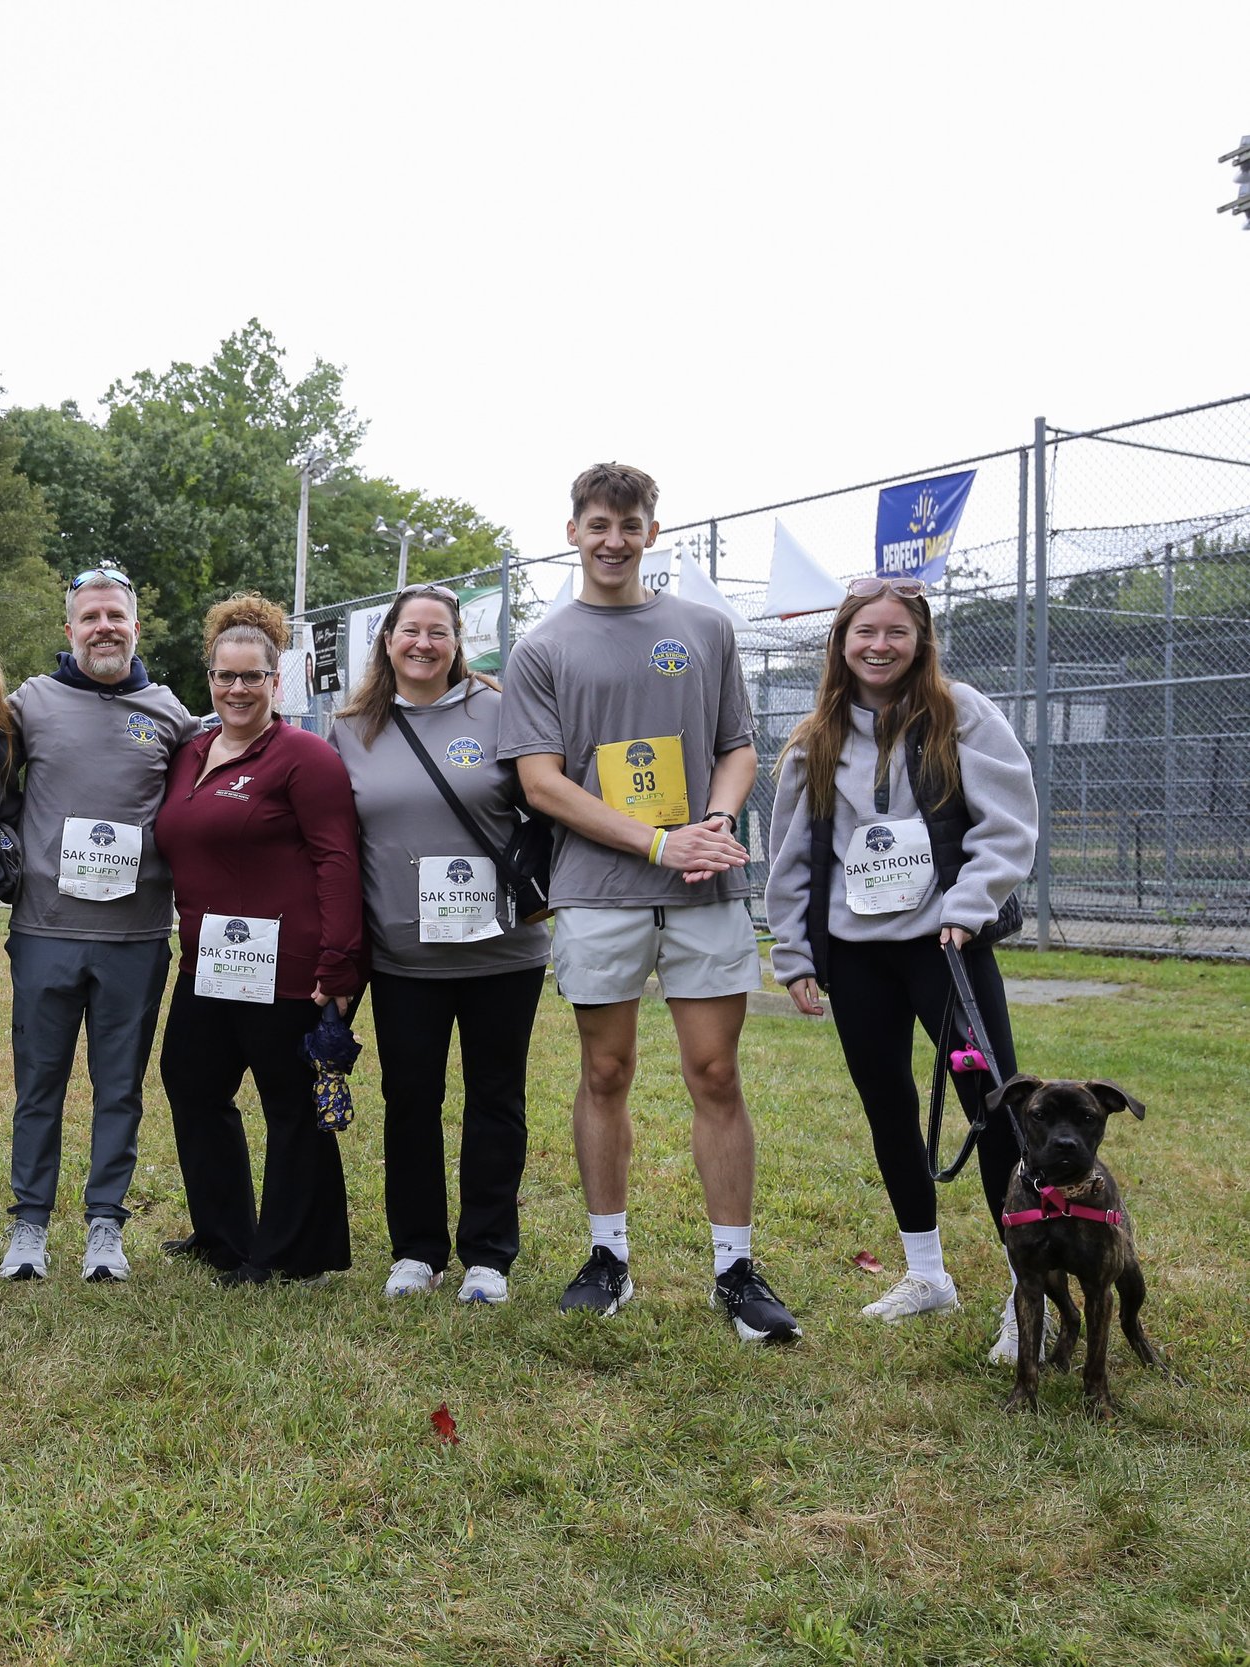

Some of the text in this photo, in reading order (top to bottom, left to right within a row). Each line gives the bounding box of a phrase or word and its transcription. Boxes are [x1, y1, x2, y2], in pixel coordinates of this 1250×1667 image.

[883, 538, 924, 573] PERFECT
[632, 770, 656, 793] 93
[63, 849, 139, 867] SAK STRONG
[846, 853, 931, 876] SAK STRONG
[87, 866, 121, 876] DUFFY
[874, 871, 912, 884] DUFFY
[420, 891, 496, 902] SAK STRONG
[448, 906, 482, 914] DUFFY
[200, 946, 275, 964] SAK STRONG
[222, 963, 257, 974] DUFFY
